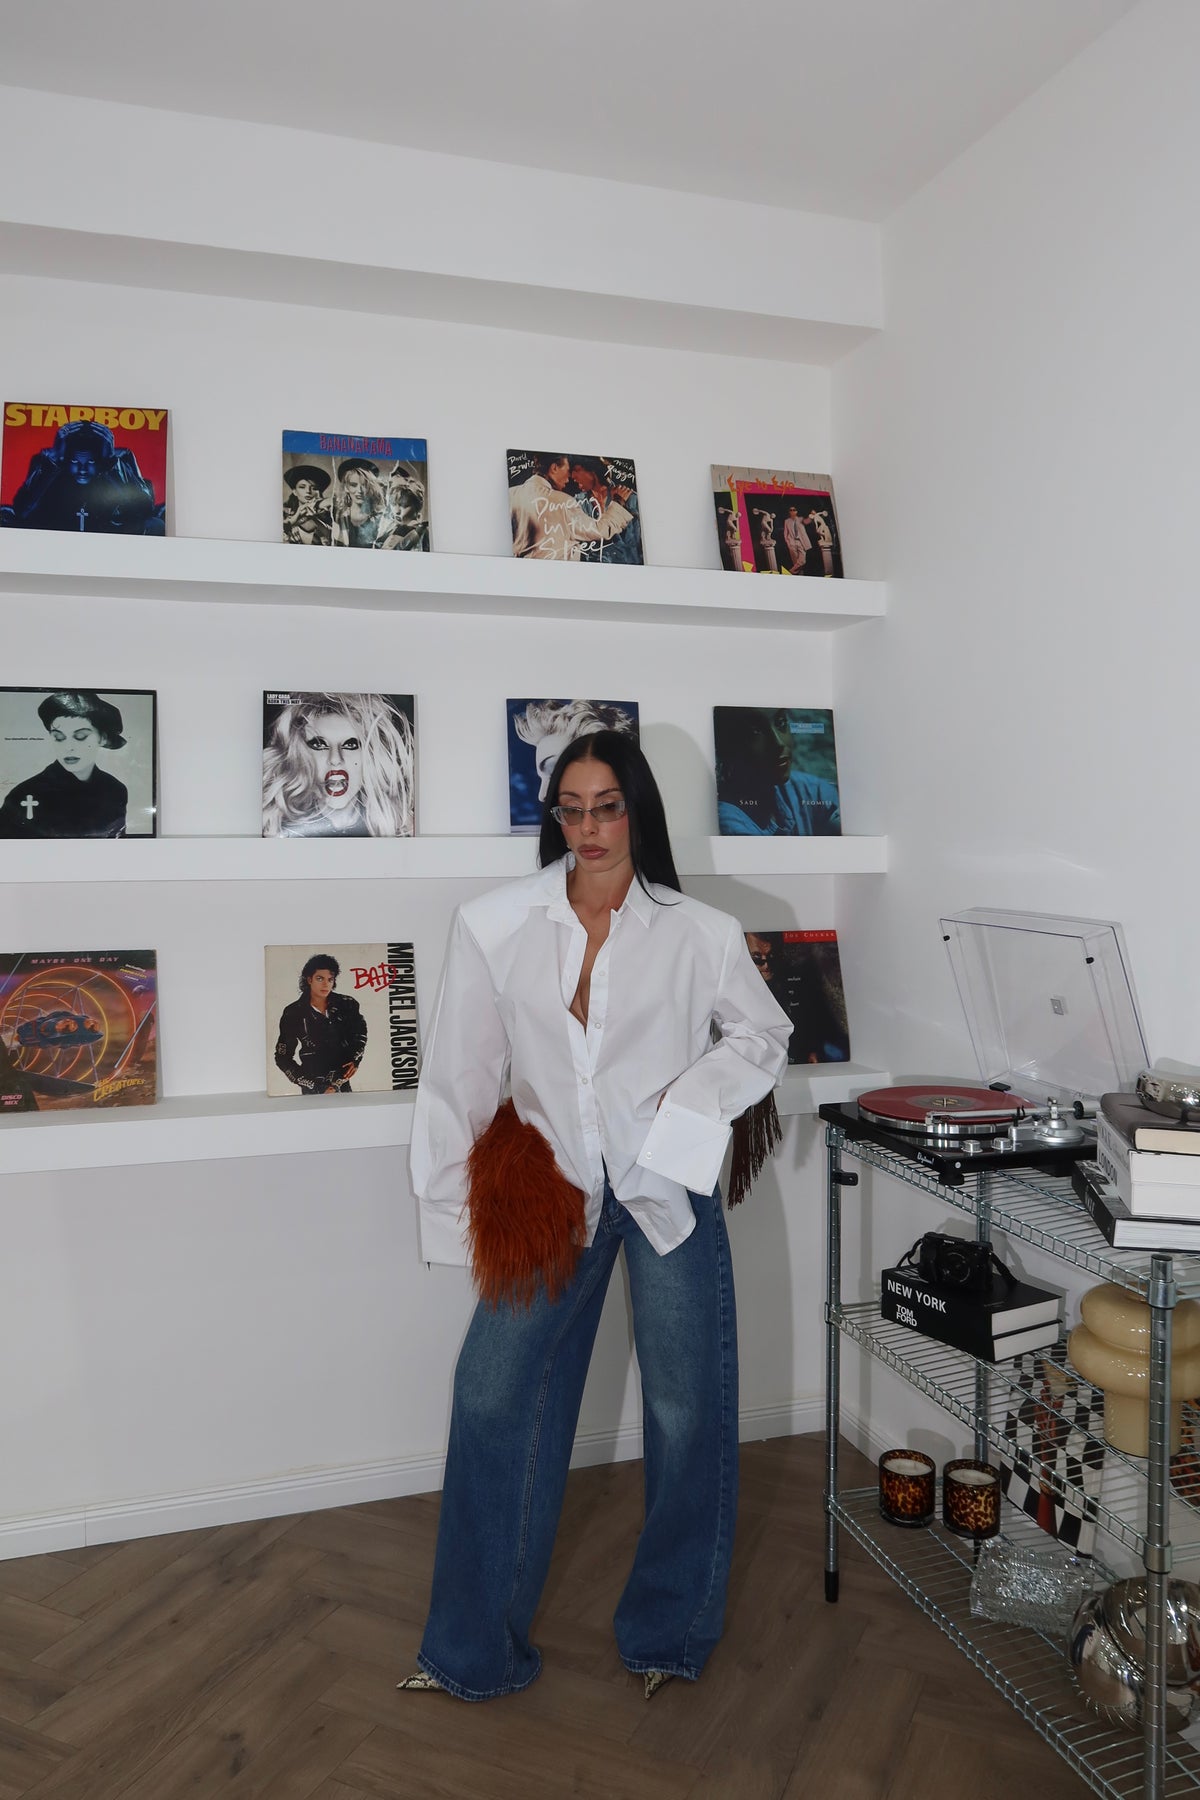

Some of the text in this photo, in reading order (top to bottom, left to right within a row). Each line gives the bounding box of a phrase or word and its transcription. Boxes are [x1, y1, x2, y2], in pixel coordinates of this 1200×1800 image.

[5, 404, 166, 431] STARBOY
[532, 496, 601, 522] Dancing
[350, 962, 398, 992] BAD
[387, 943, 419, 1090] MICHAEL JACKSON
[887, 1279, 947, 1314] NEW YORK
[896, 1303, 914, 1318] TOM
[896, 1311, 917, 1327] FORD
